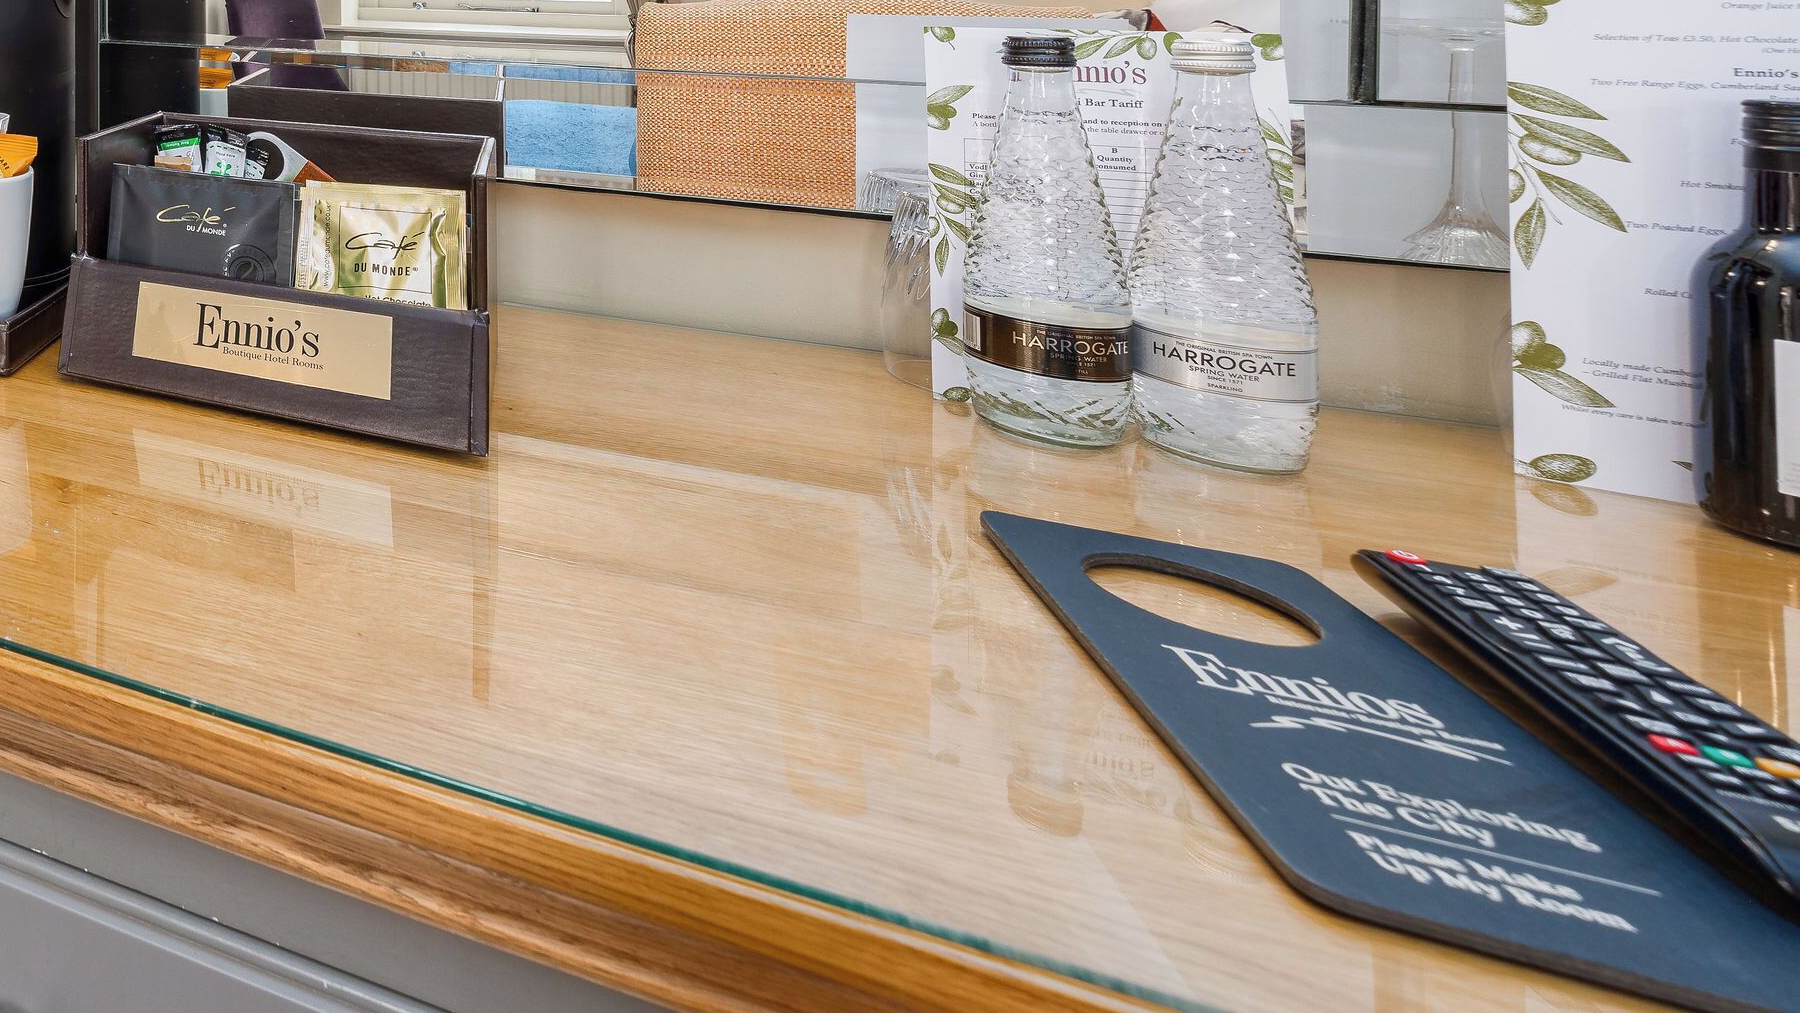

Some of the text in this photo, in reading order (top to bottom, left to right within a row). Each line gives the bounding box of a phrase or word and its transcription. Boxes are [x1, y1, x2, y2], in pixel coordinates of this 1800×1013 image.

[1072, 60, 1148, 85] nnio's
[1733, 68, 1799, 79] Ennio's
[1085, 98, 1144, 109] Bar Tariff
[972, 112, 997, 120] Please
[980, 120, 997, 128] bottl
[1111, 120, 1149, 128] reception
[1096, 155, 1133, 164] Quantity
[1704, 181, 1744, 191] Smoke
[156, 204, 236, 232] Café
[186, 224, 196, 232] DU
[345, 231, 425, 260] Café
[354, 262, 367, 273] DU
[193, 302, 320, 358] Ennio's
[1012, 330, 1129, 356] HARROGATE
[1186, 343, 1216, 353] ORIGINAL
[222, 346, 324, 370] Boutique Hotel Rooms
[1153, 341, 1296, 377] HARROGATE
[1189, 365, 1260, 383] SPRING WATER
[1207, 375, 1226, 383] SINCE
[1207, 382, 1243, 393] SPARKLING
[1160, 643, 1445, 730] Ennios
[1281, 761, 1602, 854] Out Exploring
[1298, 782, 1495, 848] The City
[1345, 829, 1469, 875] Please
[1363, 849, 1433, 885] Up
[1501, 884, 1640, 934] Room
